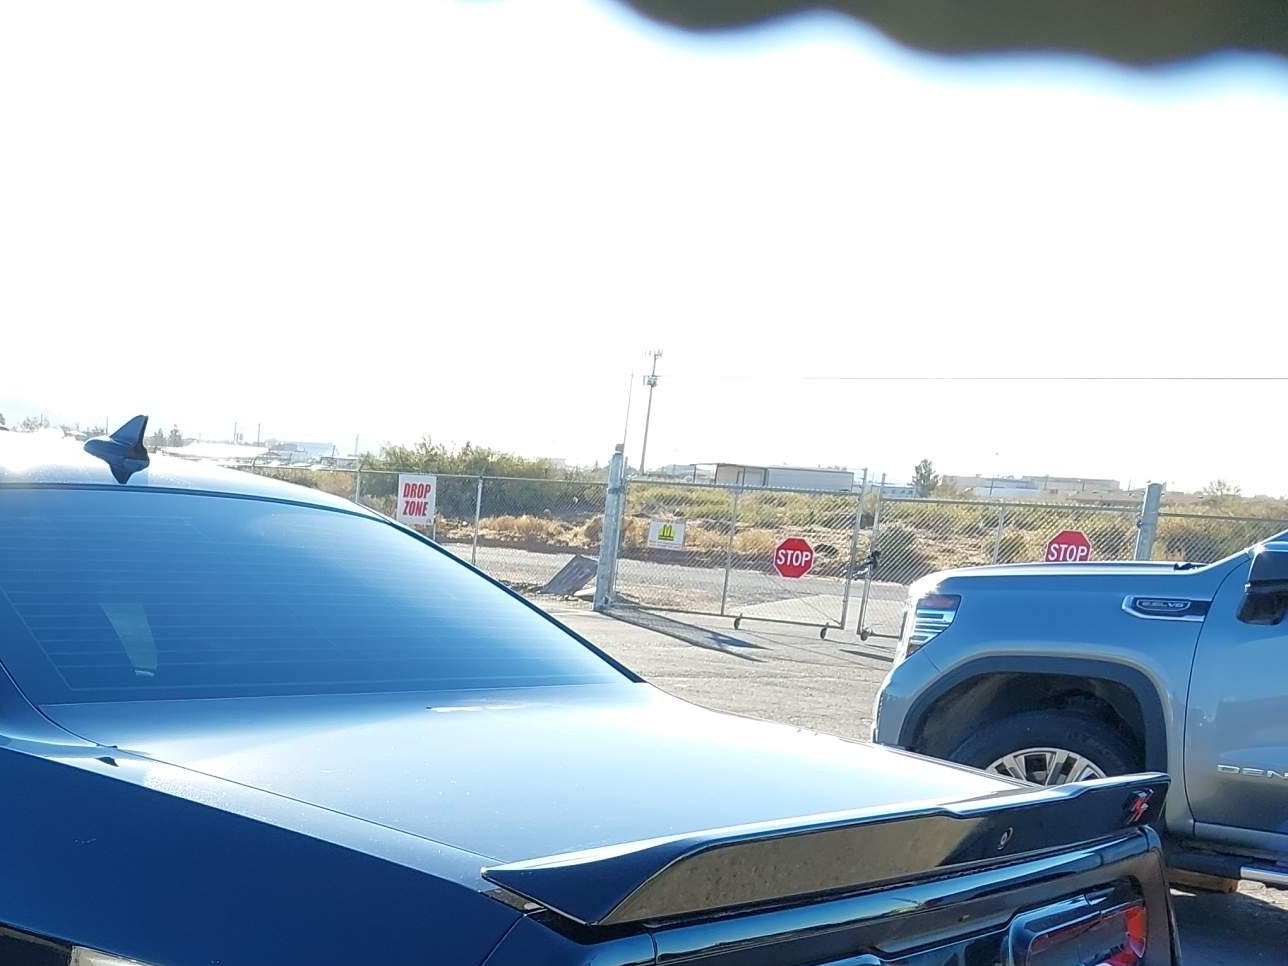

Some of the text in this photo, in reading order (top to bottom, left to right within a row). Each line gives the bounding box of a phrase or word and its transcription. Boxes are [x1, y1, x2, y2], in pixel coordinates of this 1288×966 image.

[402, 482, 431, 498] DROP
[402, 501, 429, 516] ZONE
[776, 549, 811, 567] STOP
[1048, 543, 1088, 562] STOP
